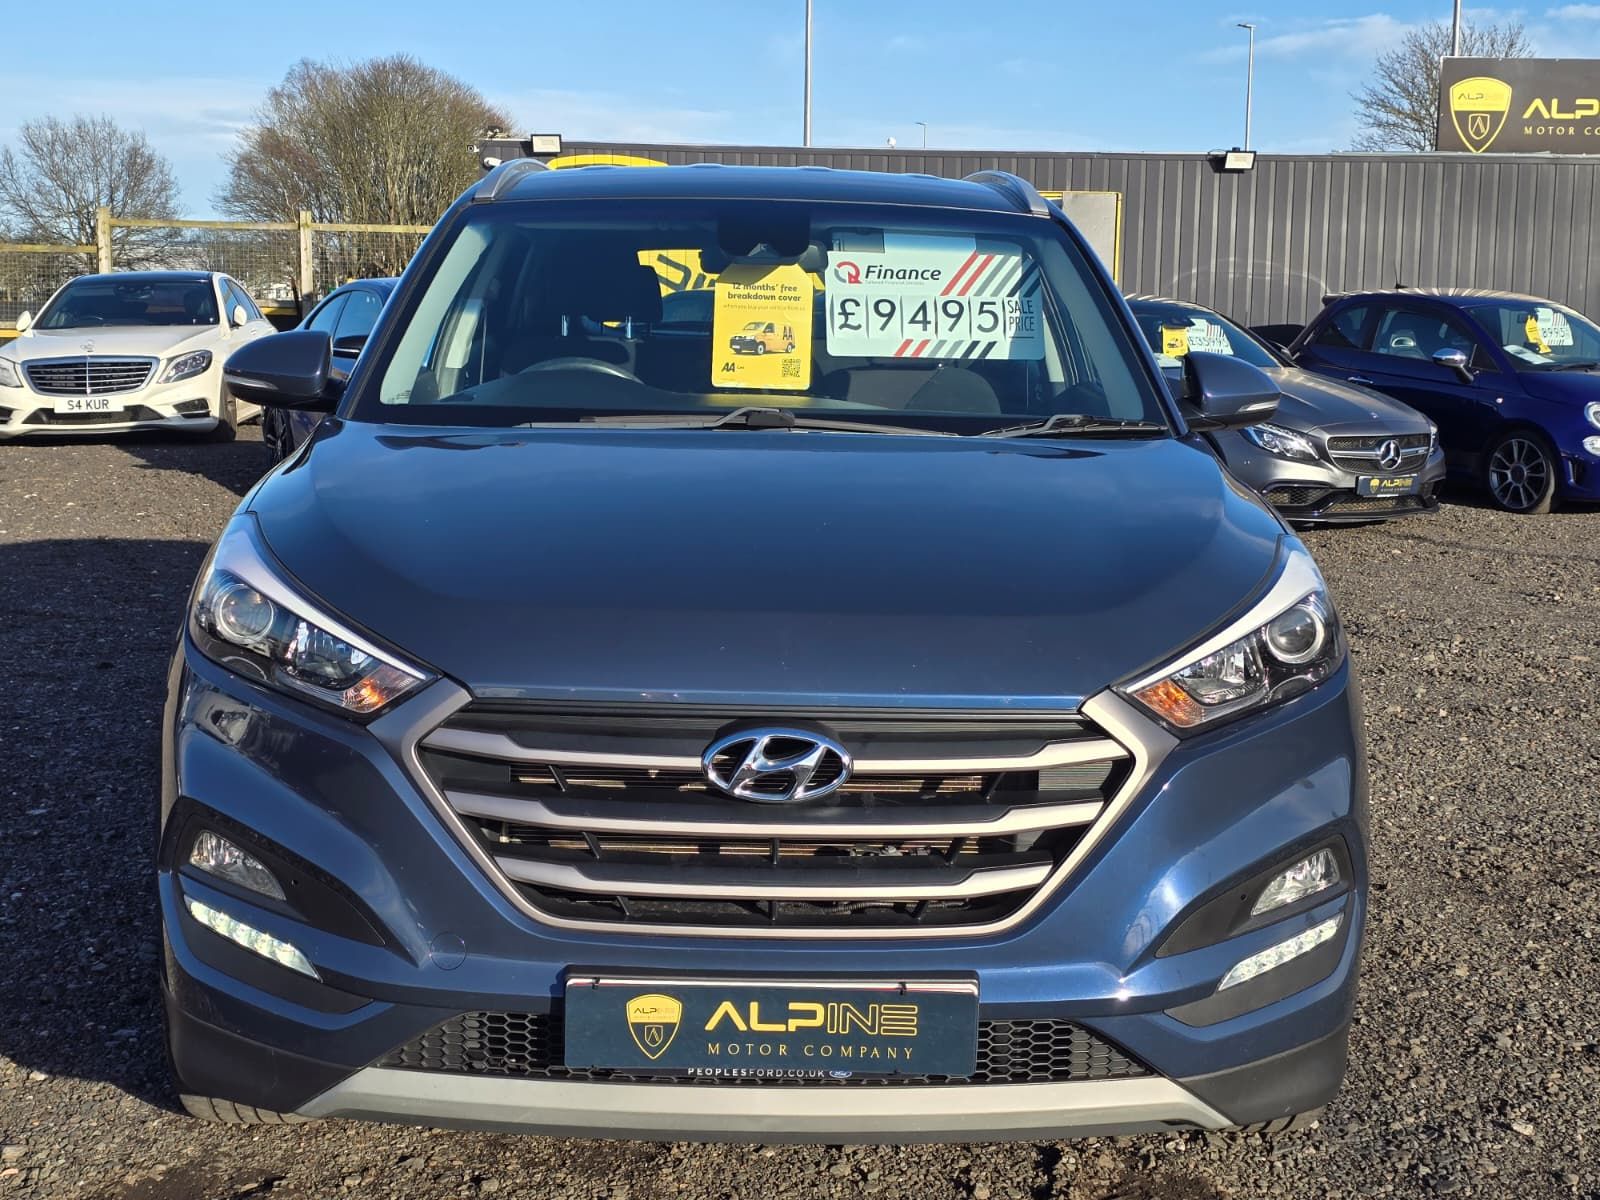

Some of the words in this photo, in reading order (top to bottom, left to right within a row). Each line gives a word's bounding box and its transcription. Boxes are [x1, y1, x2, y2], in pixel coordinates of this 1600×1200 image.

[1523, 125, 1576, 136] MOTOR
[864, 264, 942, 282] Finance
[780, 283, 798, 294] free
[727, 291, 776, 301] breakdown
[778, 294, 802, 302] cover
[1006, 299, 1035, 315] SALE
[837, 298, 1000, 334] £9495
[1008, 315, 1035, 332] PRICE
[721, 362, 736, 373] AA
[67, 399, 82, 411] S4
[85, 398, 110, 410] KUR
[704, 1001, 918, 1036] ALPINE
[707, 1042, 788, 1057] MOTOR
[803, 1044, 913, 1060] COMPANY
[687, 1067, 825, 1078] PEOPLESFORD.CO.UK
